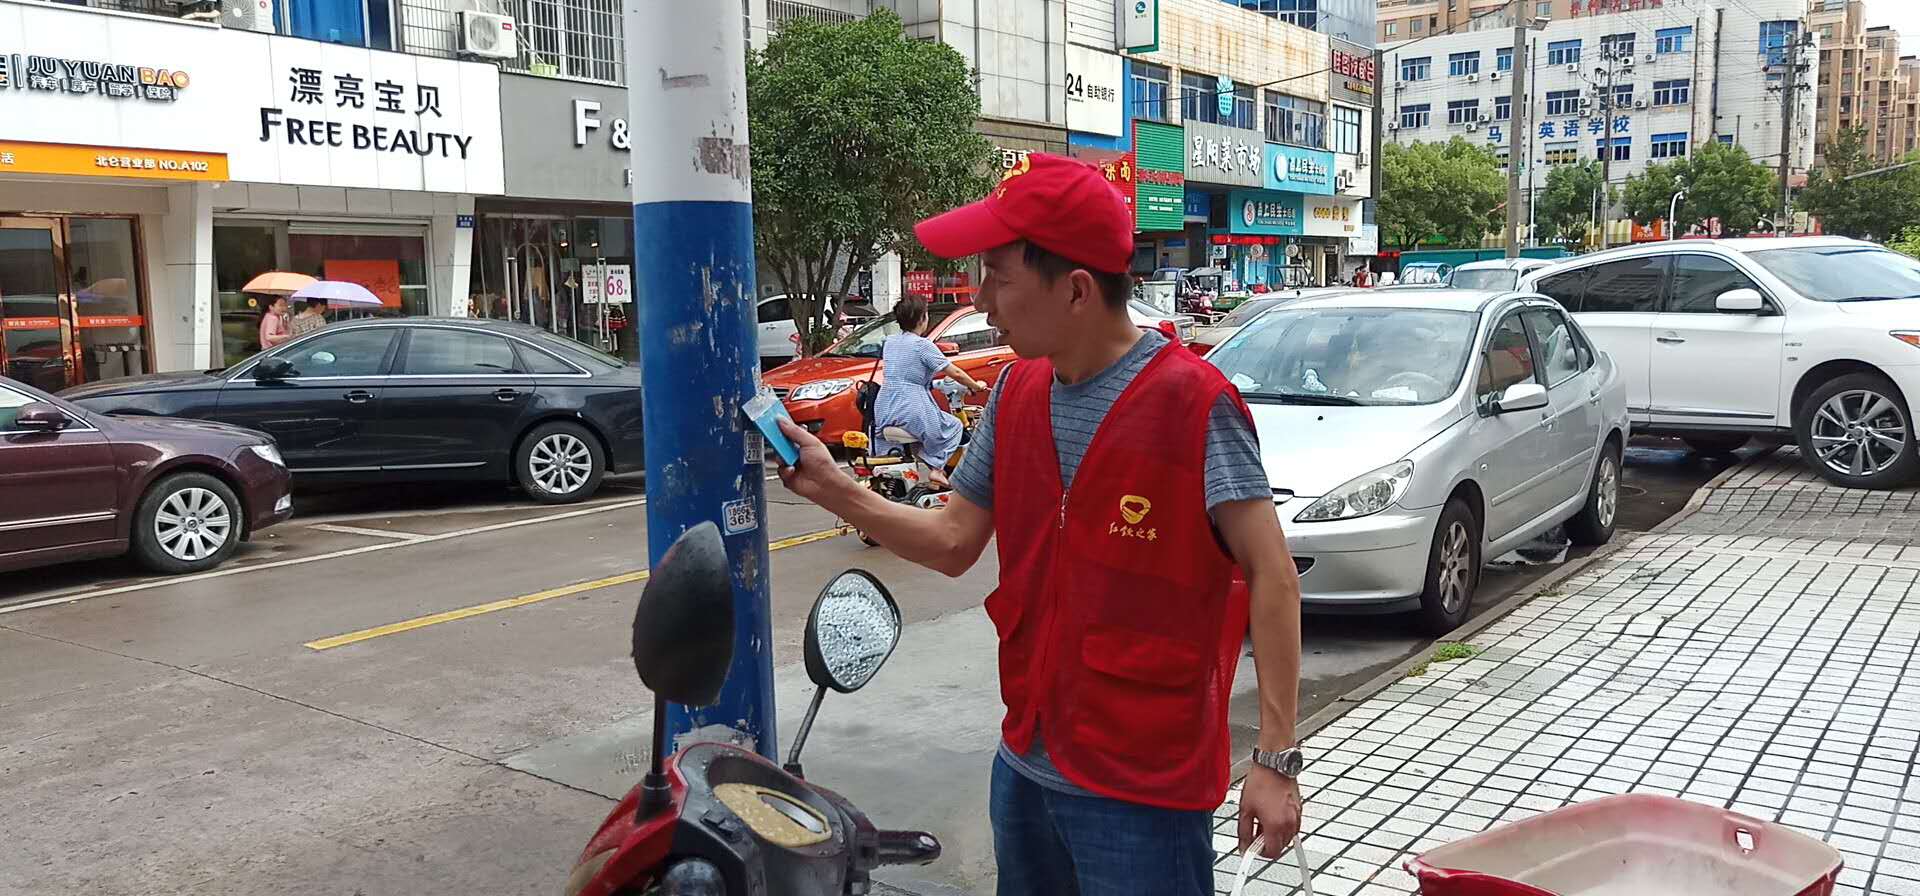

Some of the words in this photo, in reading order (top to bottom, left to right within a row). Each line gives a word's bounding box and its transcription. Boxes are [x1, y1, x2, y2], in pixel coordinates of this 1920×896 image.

[30, 75, 59, 90] 汽车
[70, 80, 97, 93] 房产
[289, 67, 442, 117] 漂亮宝贝
[1066, 73, 1083, 97] 24
[1086, 84, 1115, 102] 自助银行
[573, 99, 602, 146] F
[352, 123, 473, 160] BEAUTY
[96, 155, 155, 169] 北仑营业部
[1192, 135, 1261, 176] 星阳菜市场
[607, 275, 624, 296] 68
